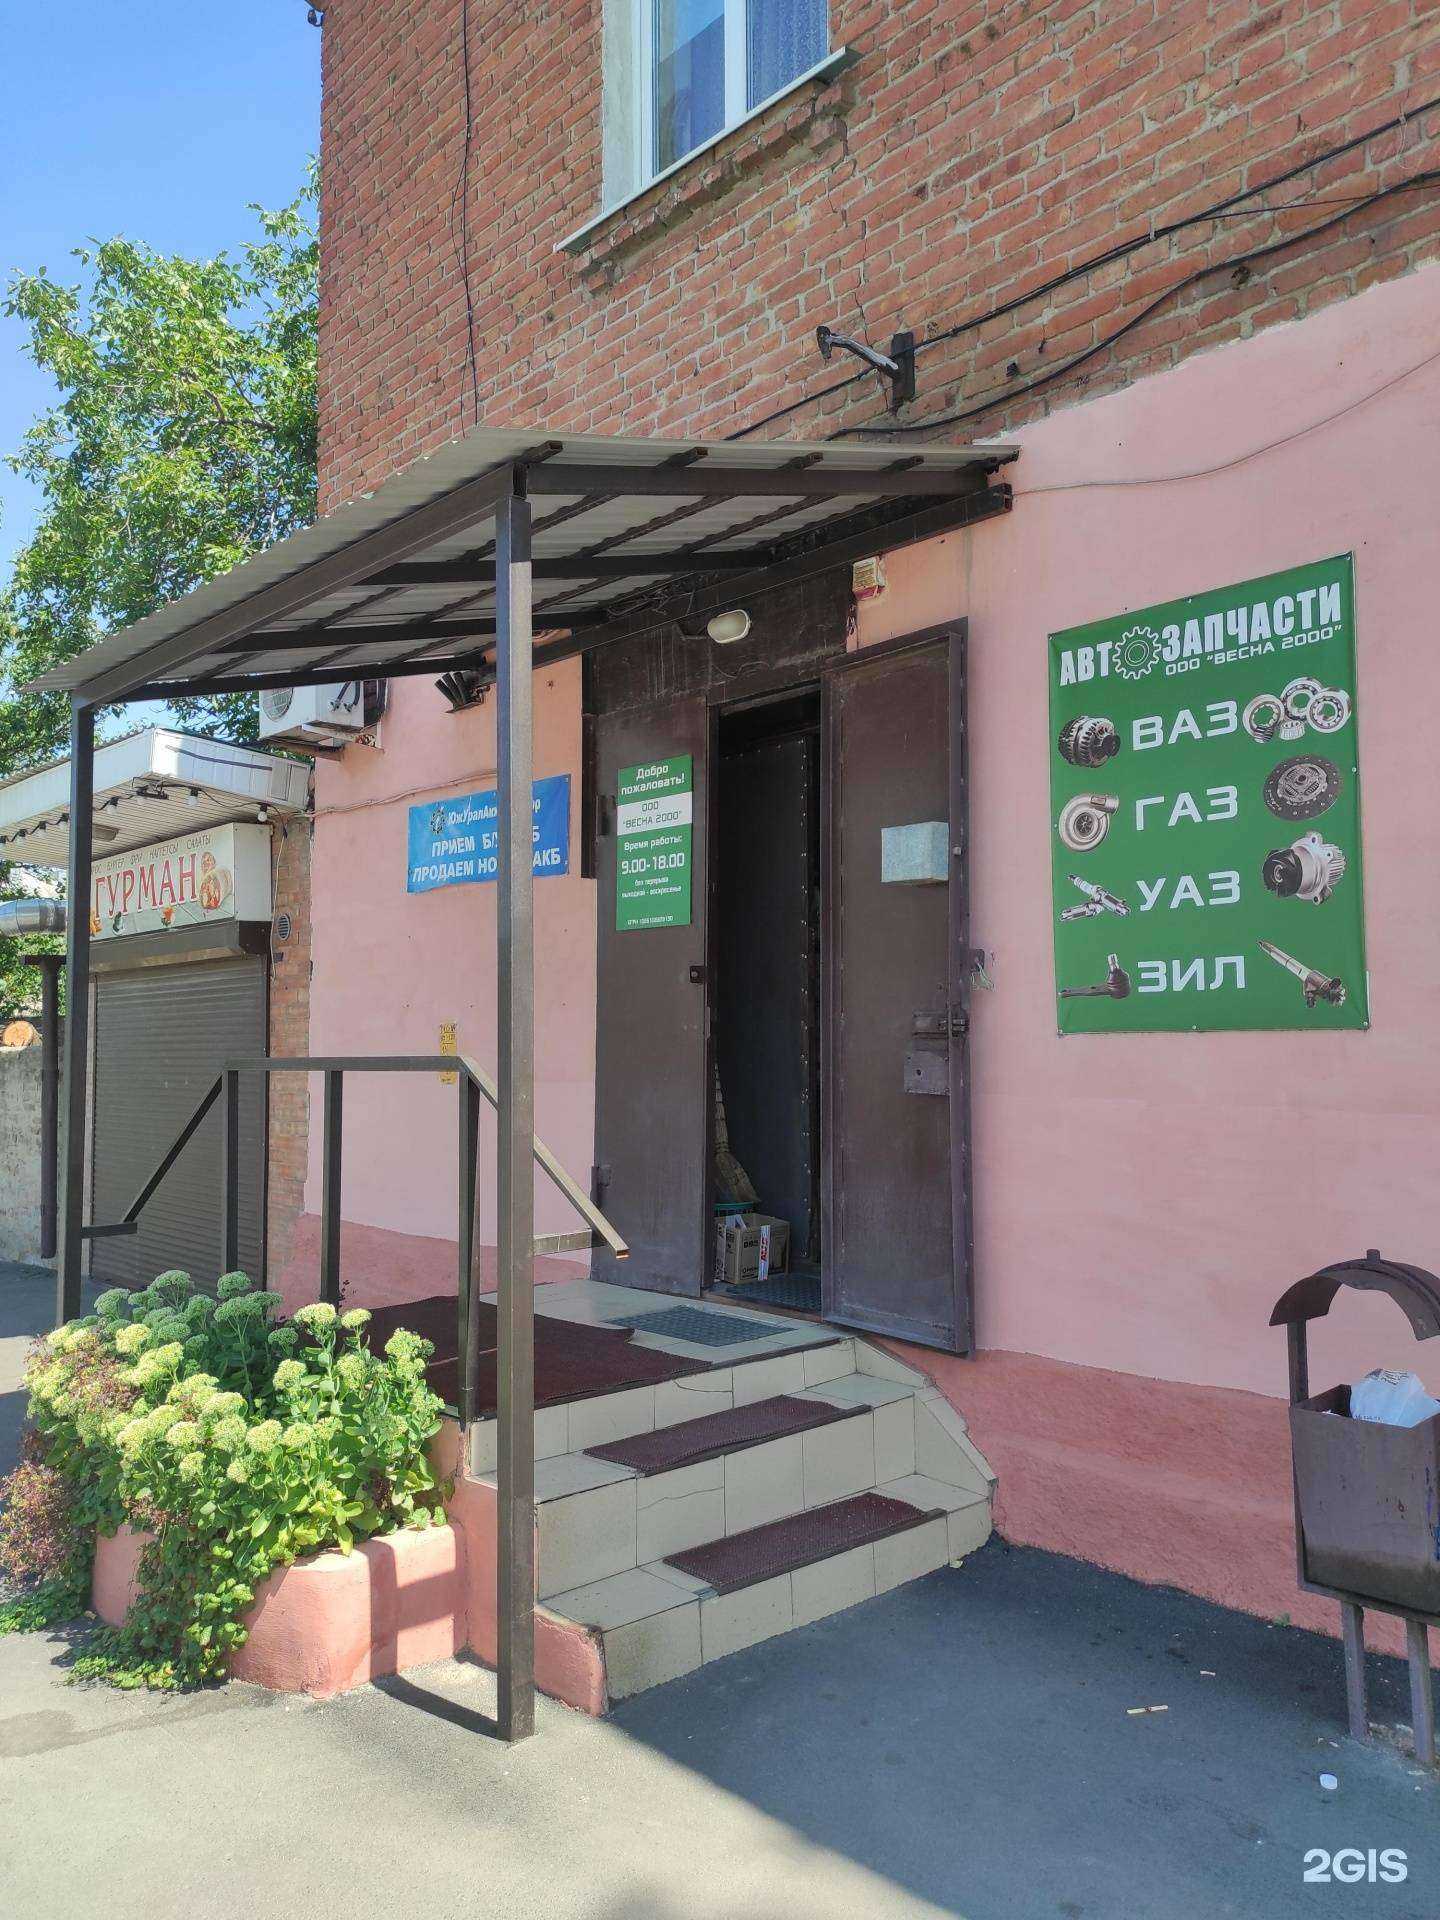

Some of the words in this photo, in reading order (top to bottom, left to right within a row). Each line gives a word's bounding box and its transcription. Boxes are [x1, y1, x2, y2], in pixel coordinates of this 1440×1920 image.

[1165, 657, 1201, 676] ООО
[1132, 700, 1239, 751] ВАЗ
[621, 772, 685, 796] пожаловать!
[636, 764, 669, 781] Добро
[641, 800, 659, 812] ООО
[1135, 785, 1239, 831] ГАЗ
[432, 835, 475, 857] ПРИЕМ
[624, 838, 649, 853] Время
[412, 859, 474, 883] ПРОДАЕМ
[532, 847, 561, 868] АКБ
[94, 852, 198, 920] ГУРМАН
[1136, 870, 1241, 912] УАЗ
[1137, 955, 1247, 993] ЗИЛ
